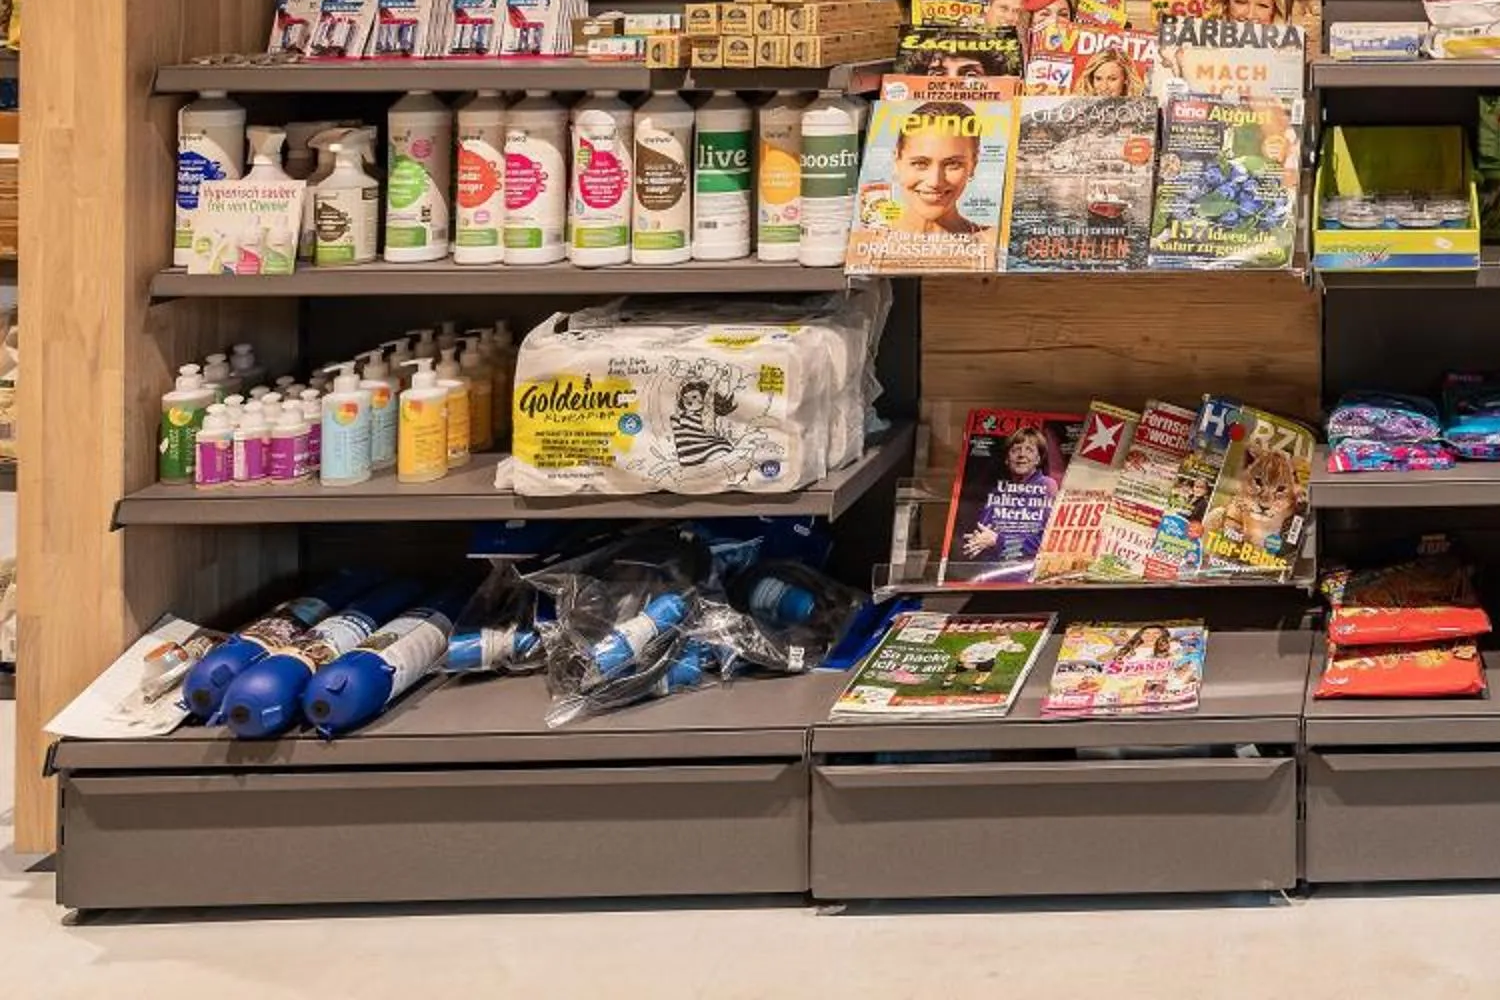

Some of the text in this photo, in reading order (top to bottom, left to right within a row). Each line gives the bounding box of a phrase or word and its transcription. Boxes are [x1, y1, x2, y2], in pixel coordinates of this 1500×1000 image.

[1036, 63, 1071, 83] sky
[1196, 64, 1268, 81] MACH
[997, 480, 1047, 495] Unsere
[992, 507, 1044, 521] Merkel
